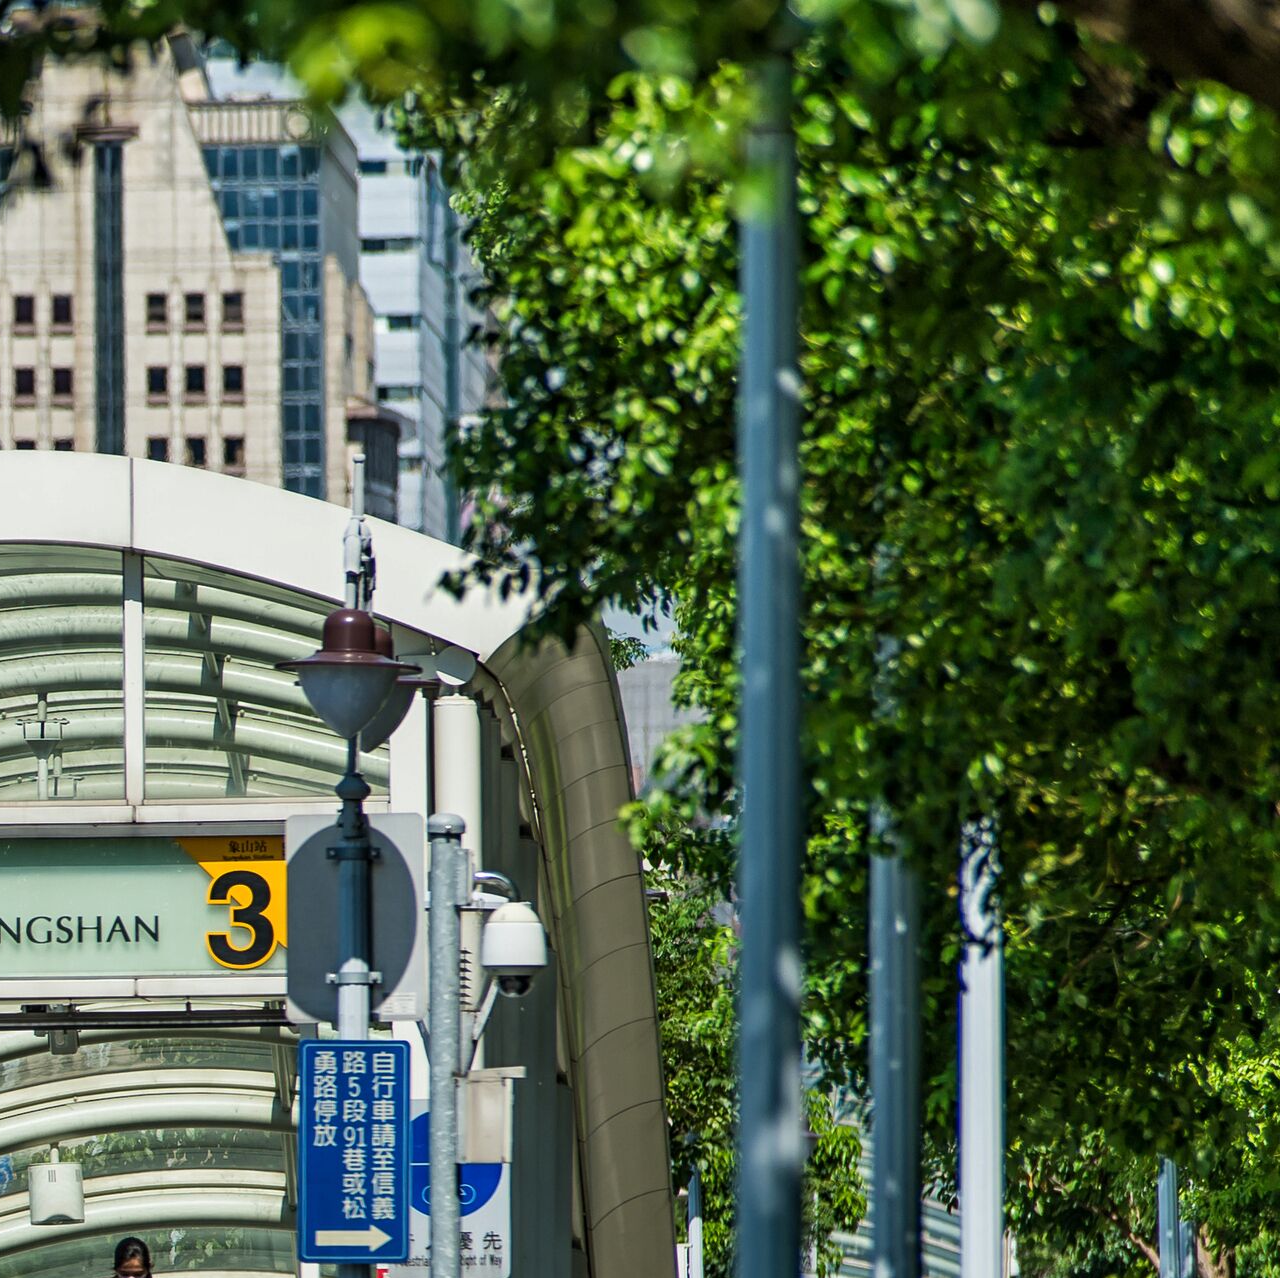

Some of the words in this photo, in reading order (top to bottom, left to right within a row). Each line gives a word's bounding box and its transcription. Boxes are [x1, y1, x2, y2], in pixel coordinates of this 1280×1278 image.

[207, 869, 275, 966] 3
[313, 1051, 338, 1147] 勇路停放
[342, 1051, 367, 1220] 路5段91巷或松
[371, 1050, 396, 1220] 自行車請至信義
